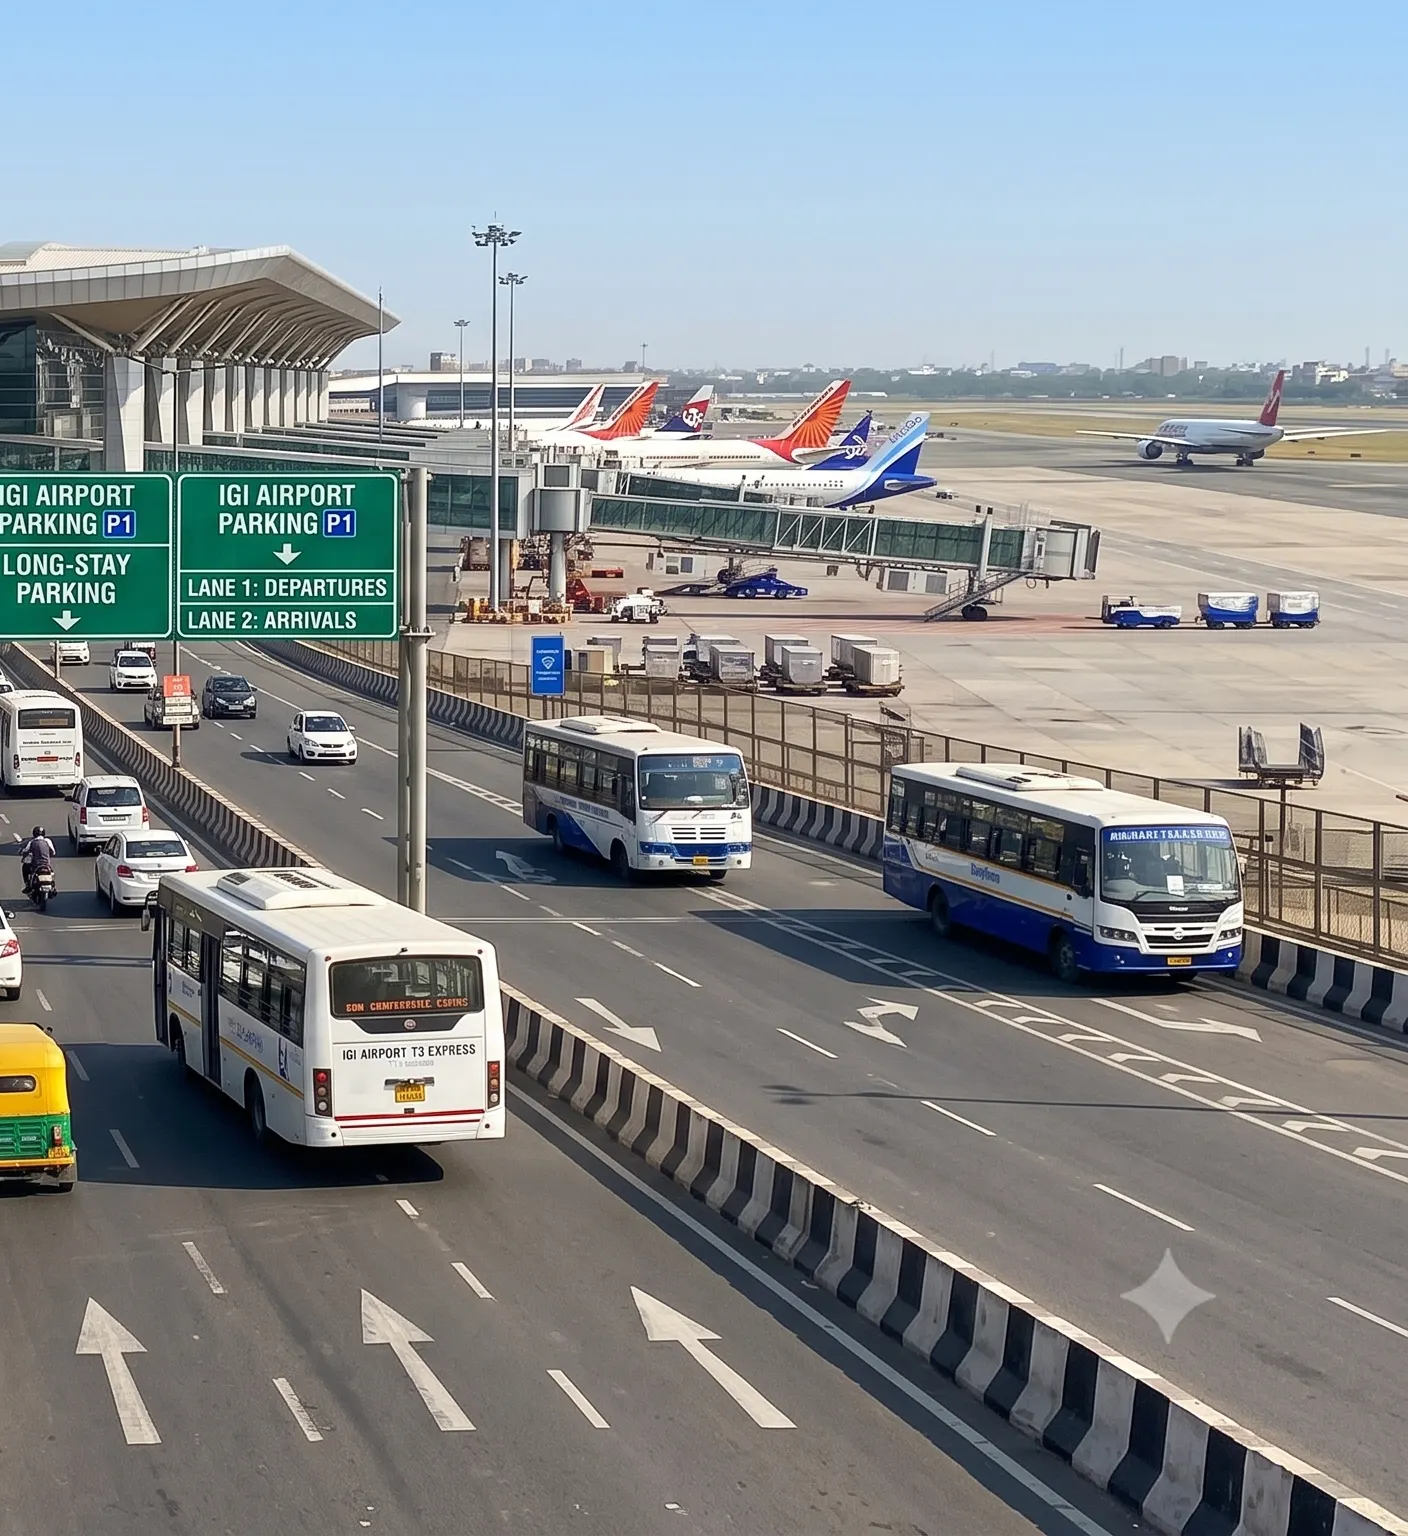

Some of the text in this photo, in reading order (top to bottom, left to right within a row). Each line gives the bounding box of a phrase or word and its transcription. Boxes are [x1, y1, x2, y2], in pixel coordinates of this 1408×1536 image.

[0, 485, 135, 506] IGI AIRPORT
[220, 484, 355, 506] IGI AIRPORT
[0, 513, 132, 534] PARKING P1
[220, 513, 352, 534] PARKING P1
[4, 554, 130, 575] LONG-STAY
[18, 582, 115, 604] PARKING
[189, 579, 386, 596] LANE 1: DEPARTURES
[189, 611, 356, 629] LANE 2: ARRIVALS
[343, 1044, 475, 1060] IGI AIRPORT T3 EXPRESS
